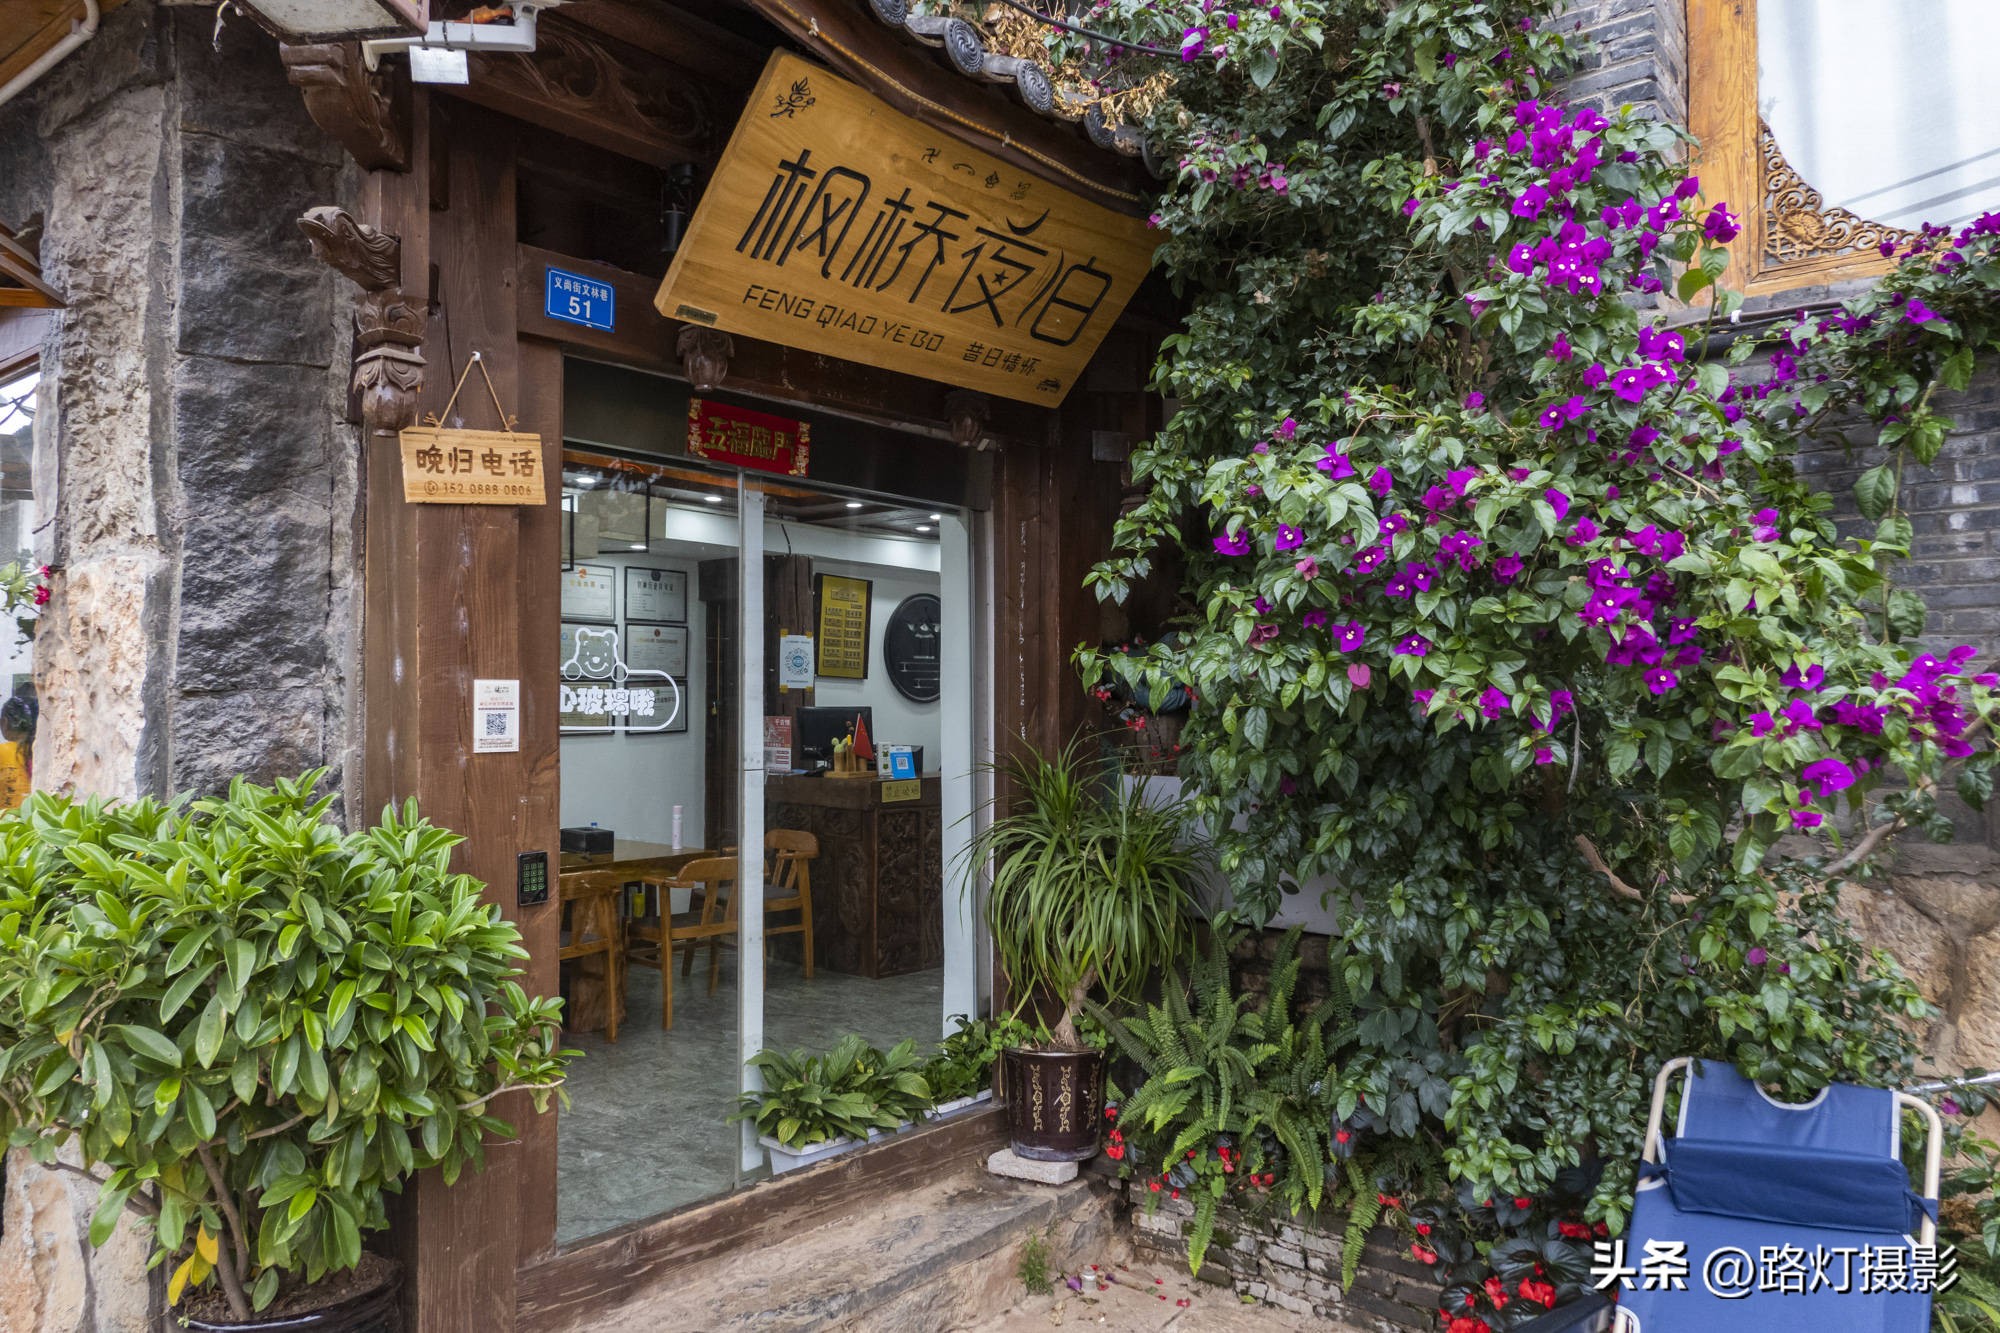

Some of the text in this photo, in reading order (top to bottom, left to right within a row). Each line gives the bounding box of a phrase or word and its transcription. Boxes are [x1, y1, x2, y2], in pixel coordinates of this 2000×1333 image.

[735, 148, 1113, 348] 枫桥夜泊
[554, 276, 608, 302] 义尚街文林巷
[568, 295, 591, 319] 51
[742, 284, 816, 320] FENG
[816, 304, 878, 336] QIAO
[962, 340, 1042, 377] 昔日情怀
[416, 443, 537, 478] 晚归电话
[443, 482, 465, 495] 152
